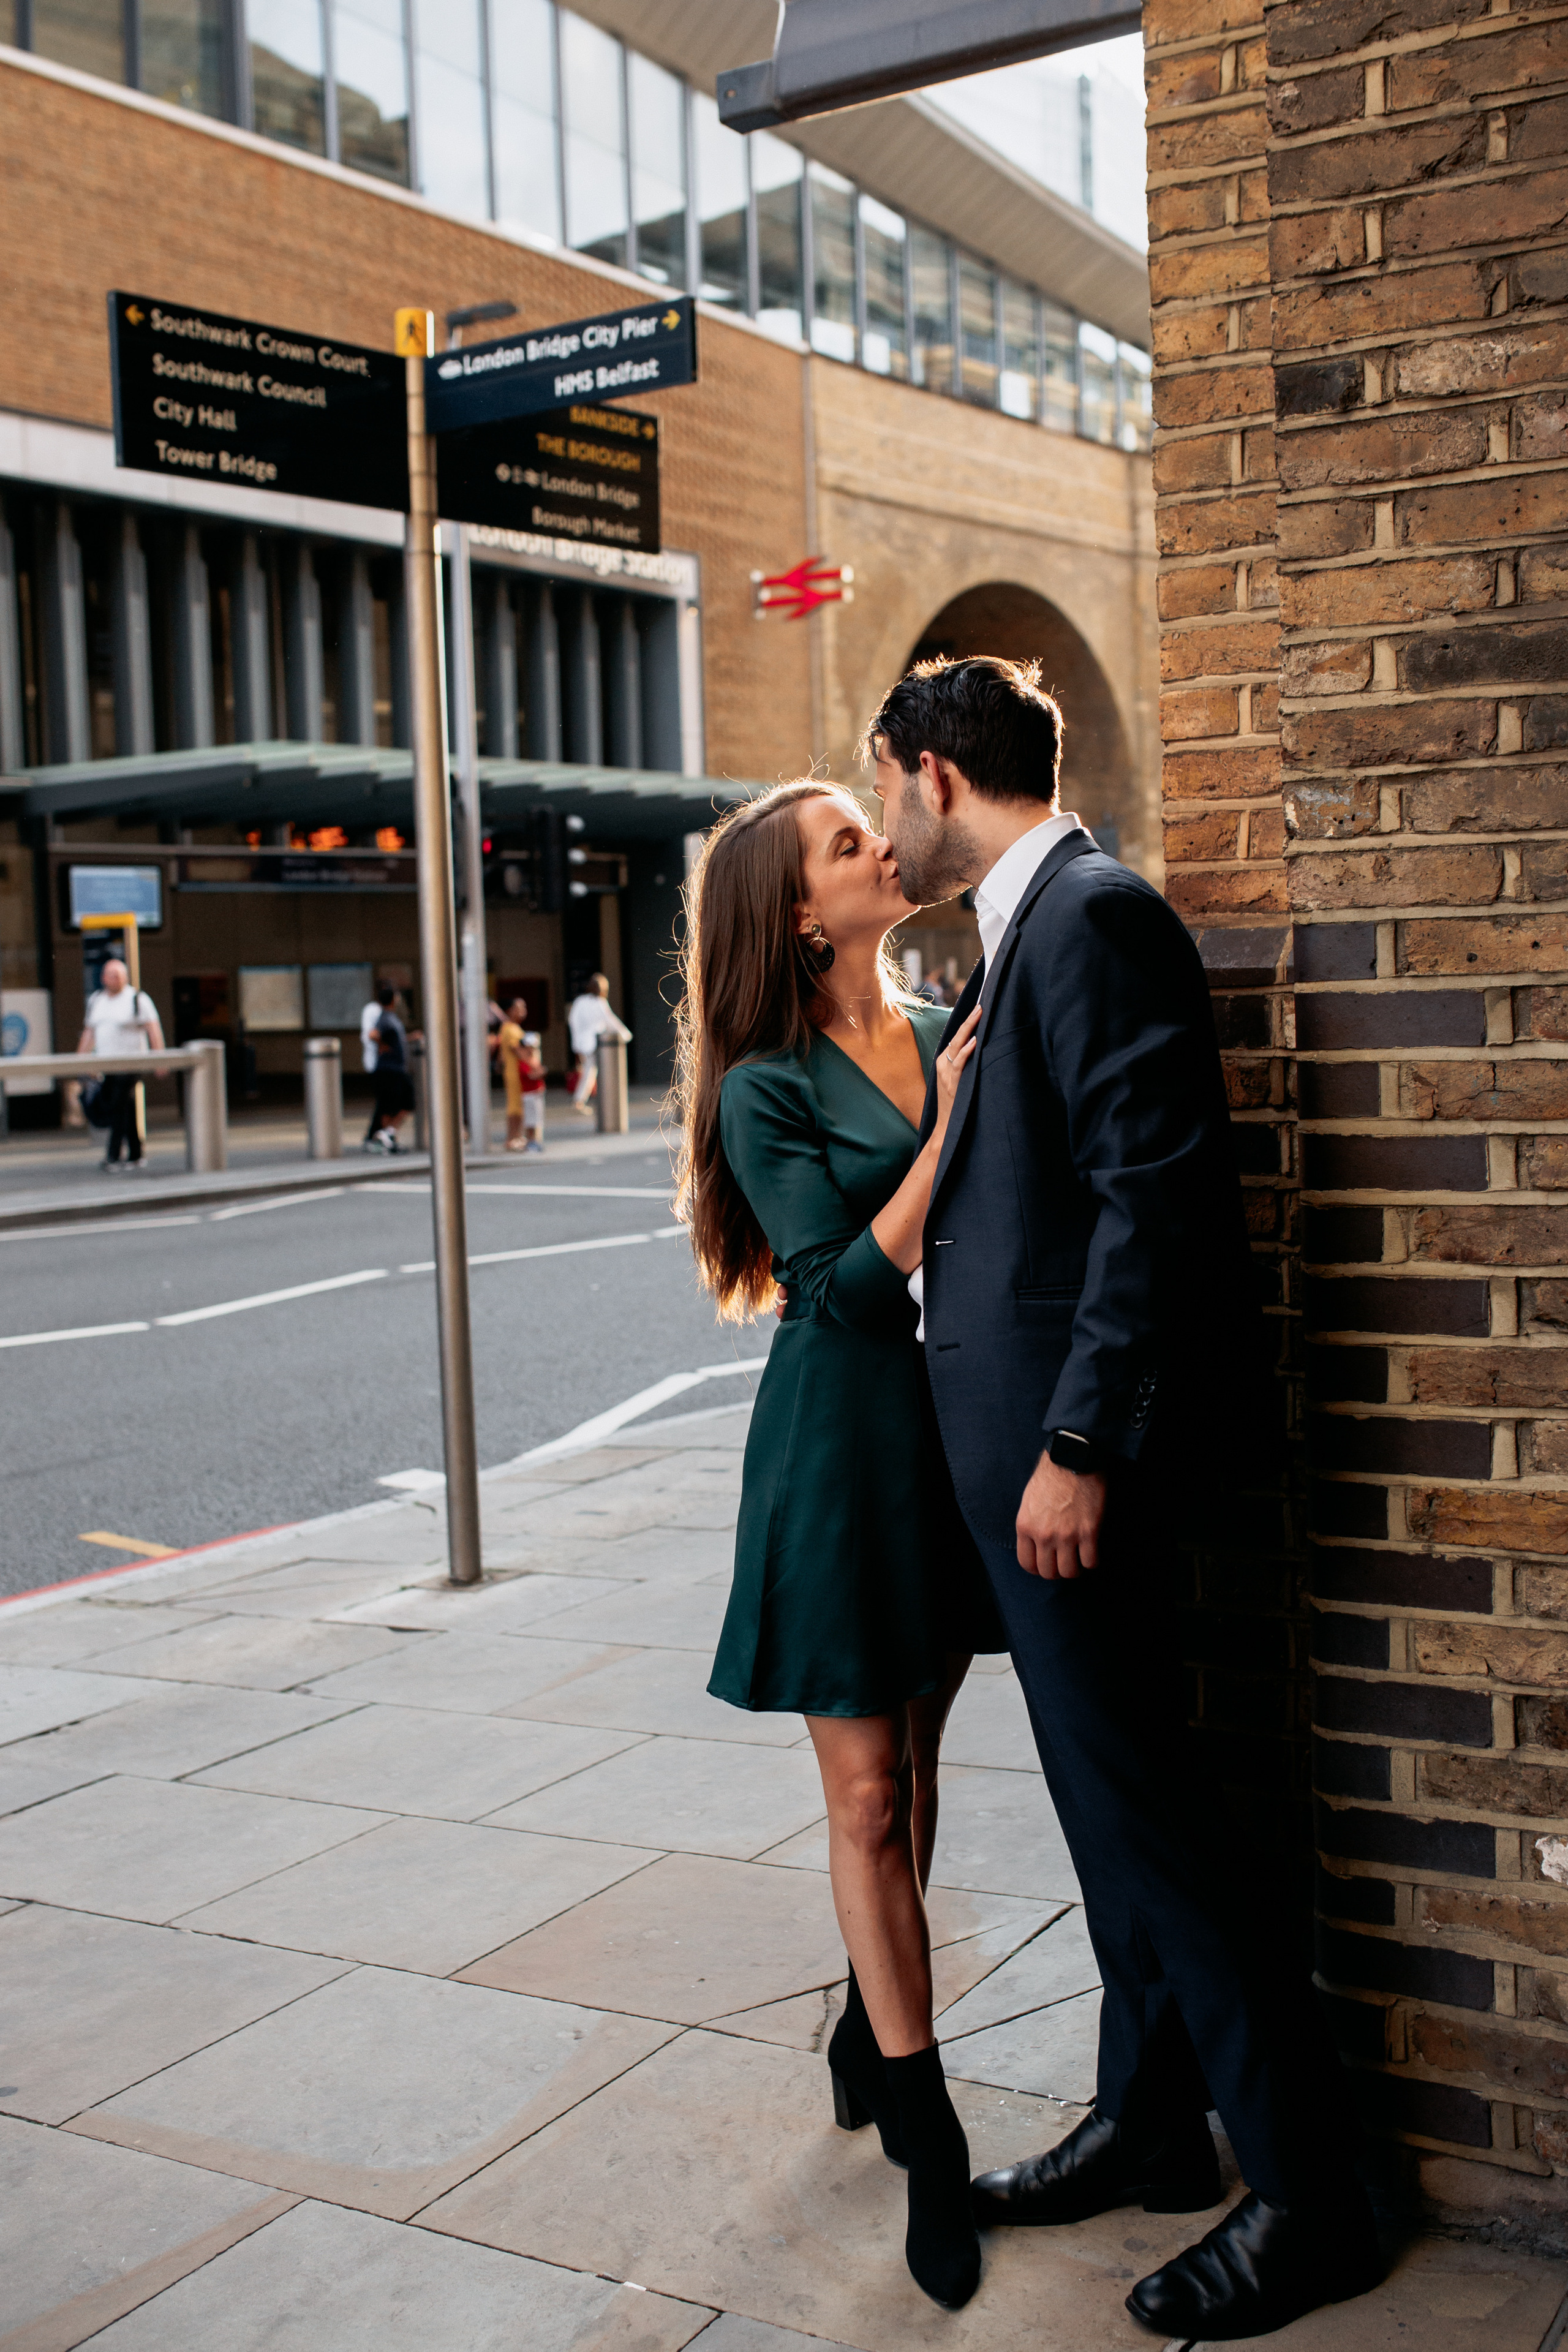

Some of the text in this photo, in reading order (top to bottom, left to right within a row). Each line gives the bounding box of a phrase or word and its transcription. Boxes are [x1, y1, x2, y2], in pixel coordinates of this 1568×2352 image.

[151, 308, 371, 376] Southwark Crown Court
[464, 315, 658, 375] London Bridge City Pier
[153, 353, 327, 407] Southwark Council
[555, 358, 660, 398] HMS Belfast
[153, 396, 237, 432] City Hall
[570, 405, 640, 437] BANKSIDE
[155, 439, 277, 483] Tower Bridge
[537, 433, 641, 472] THE BOROUGH
[541, 474, 641, 511] London Bridge
[532, 506, 641, 543] Borough Market
